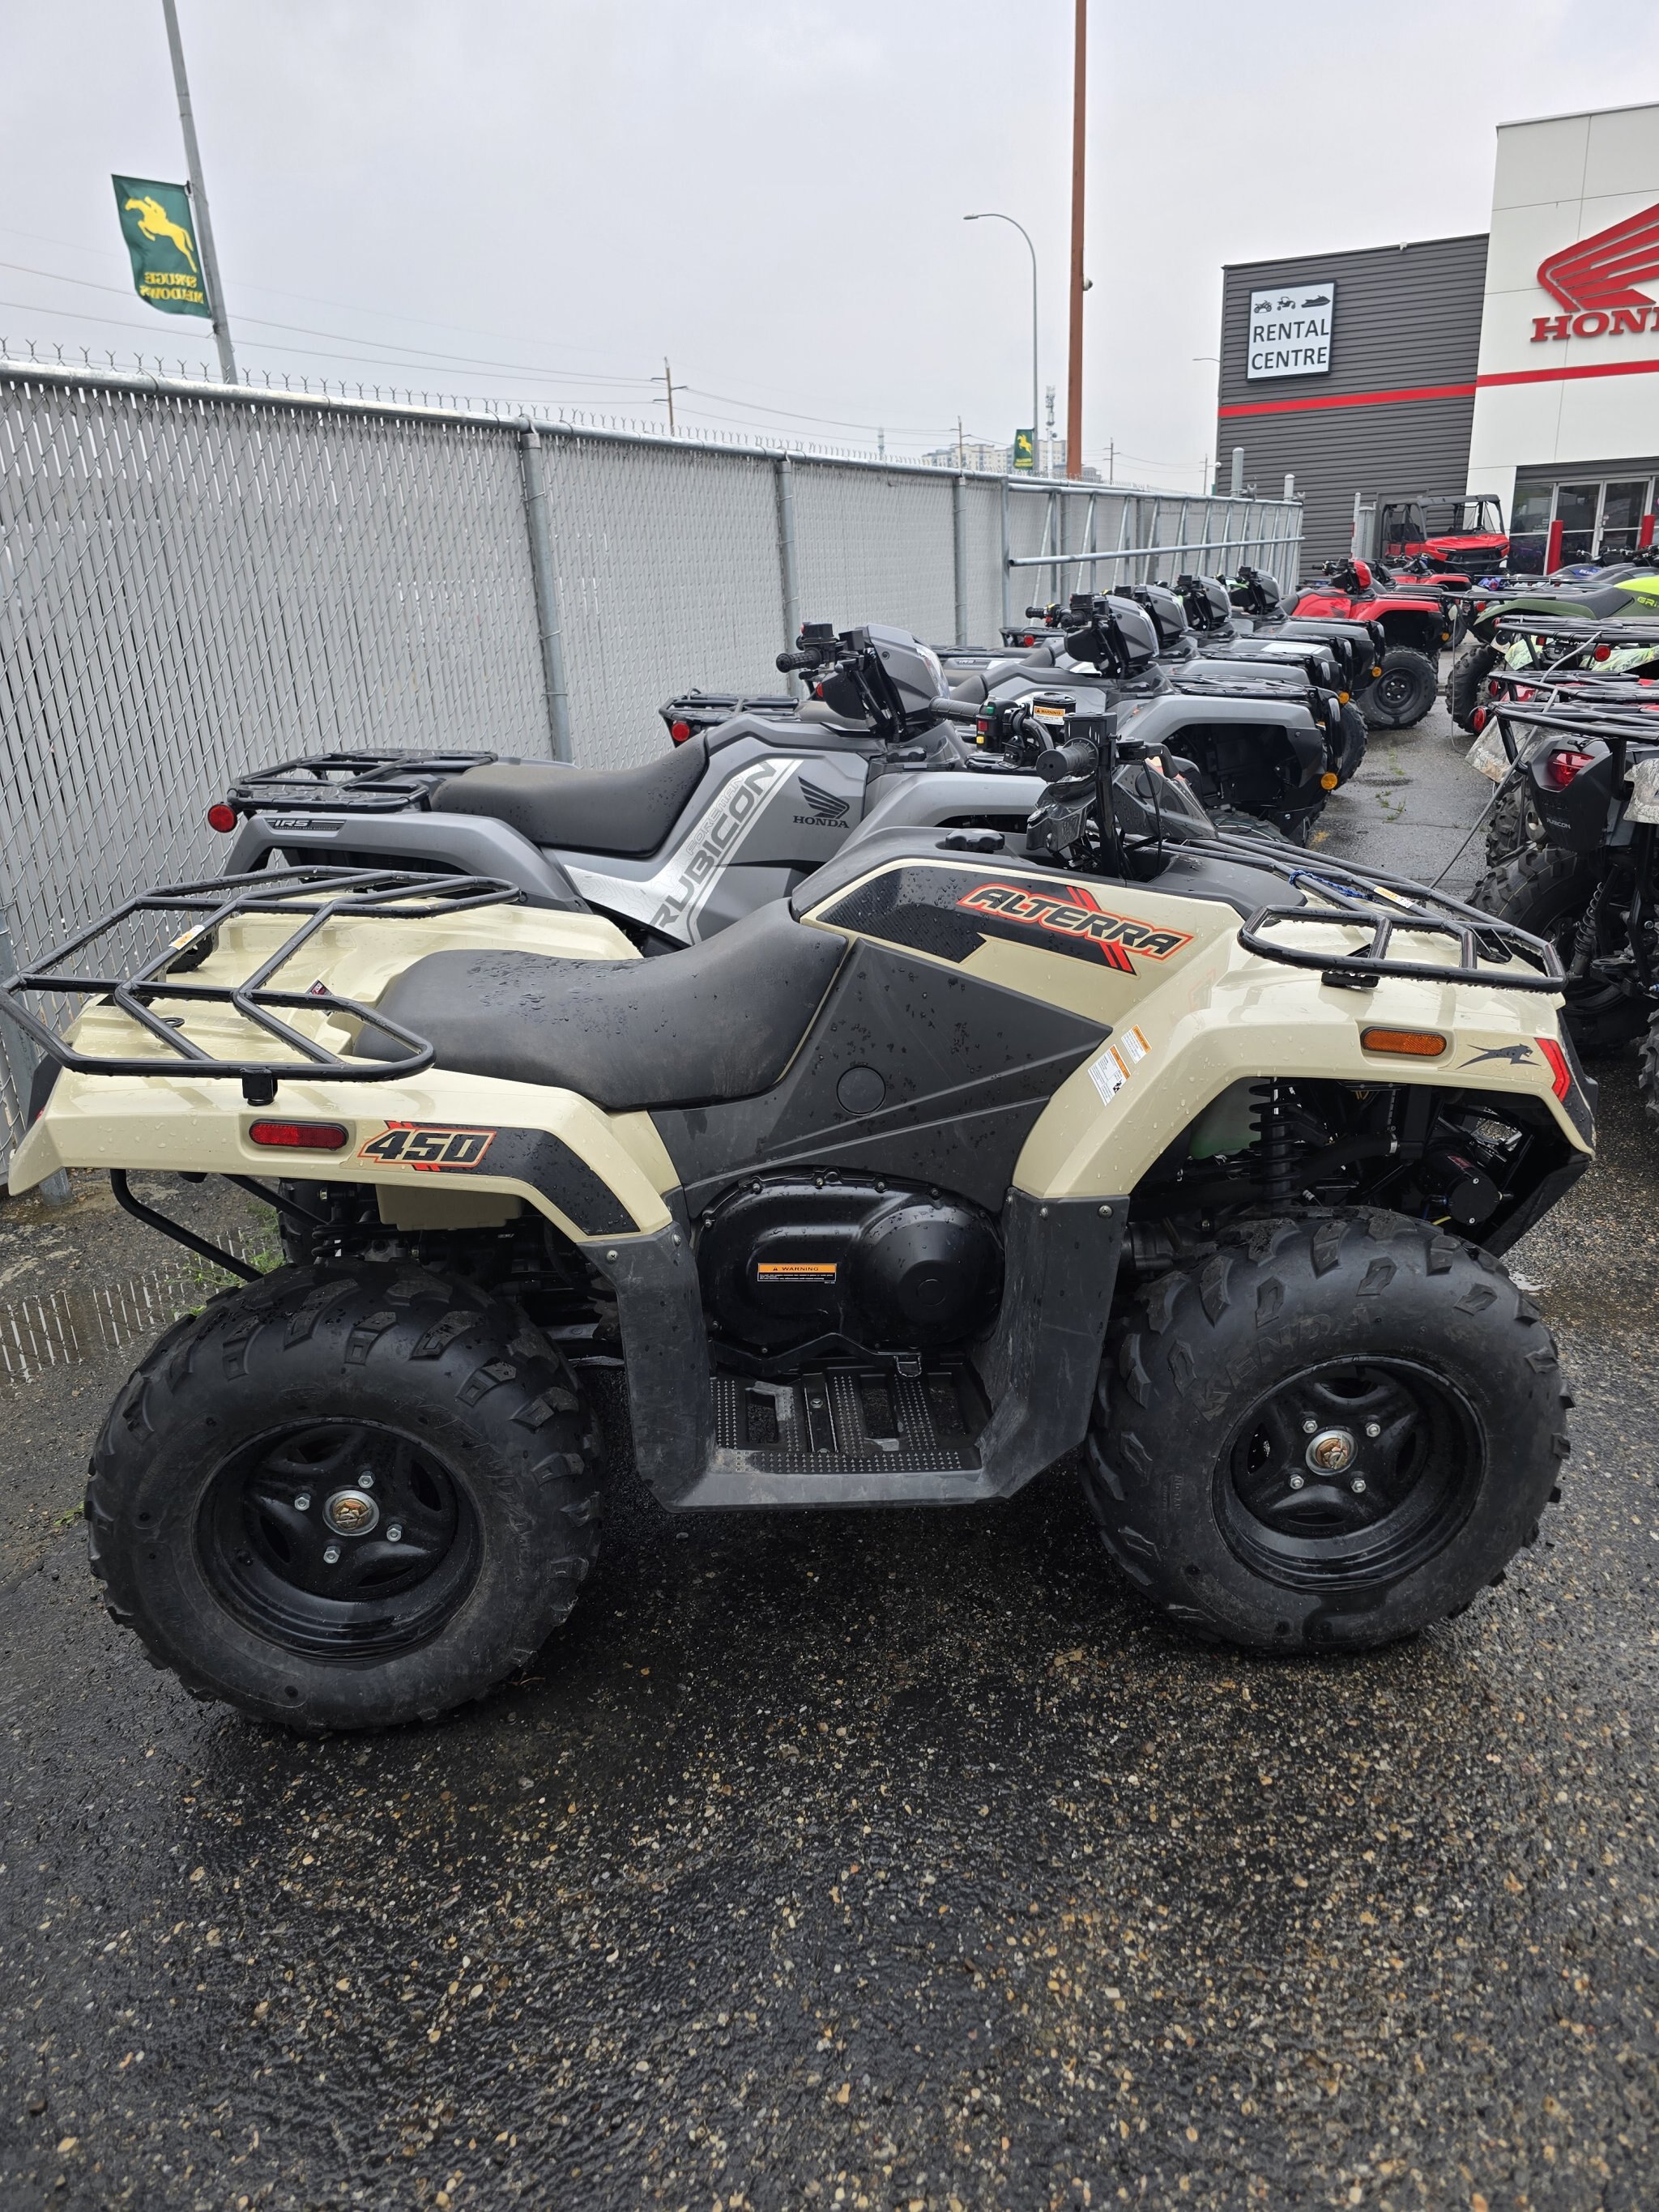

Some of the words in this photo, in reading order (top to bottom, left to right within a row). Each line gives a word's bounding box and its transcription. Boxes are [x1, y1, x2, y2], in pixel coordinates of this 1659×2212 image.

[1253, 318, 1329, 343] RENTAL
[1530, 306, 1659, 343] HON
[1252, 347, 1327, 370] CENTRE
[685, 775, 744, 856] FOREMAN
[793, 816, 850, 829] HONDA
[649, 761, 777, 928] RUBICON
[966, 887, 1185, 956] ALTERRA
[364, 1130, 491, 1163] 450
